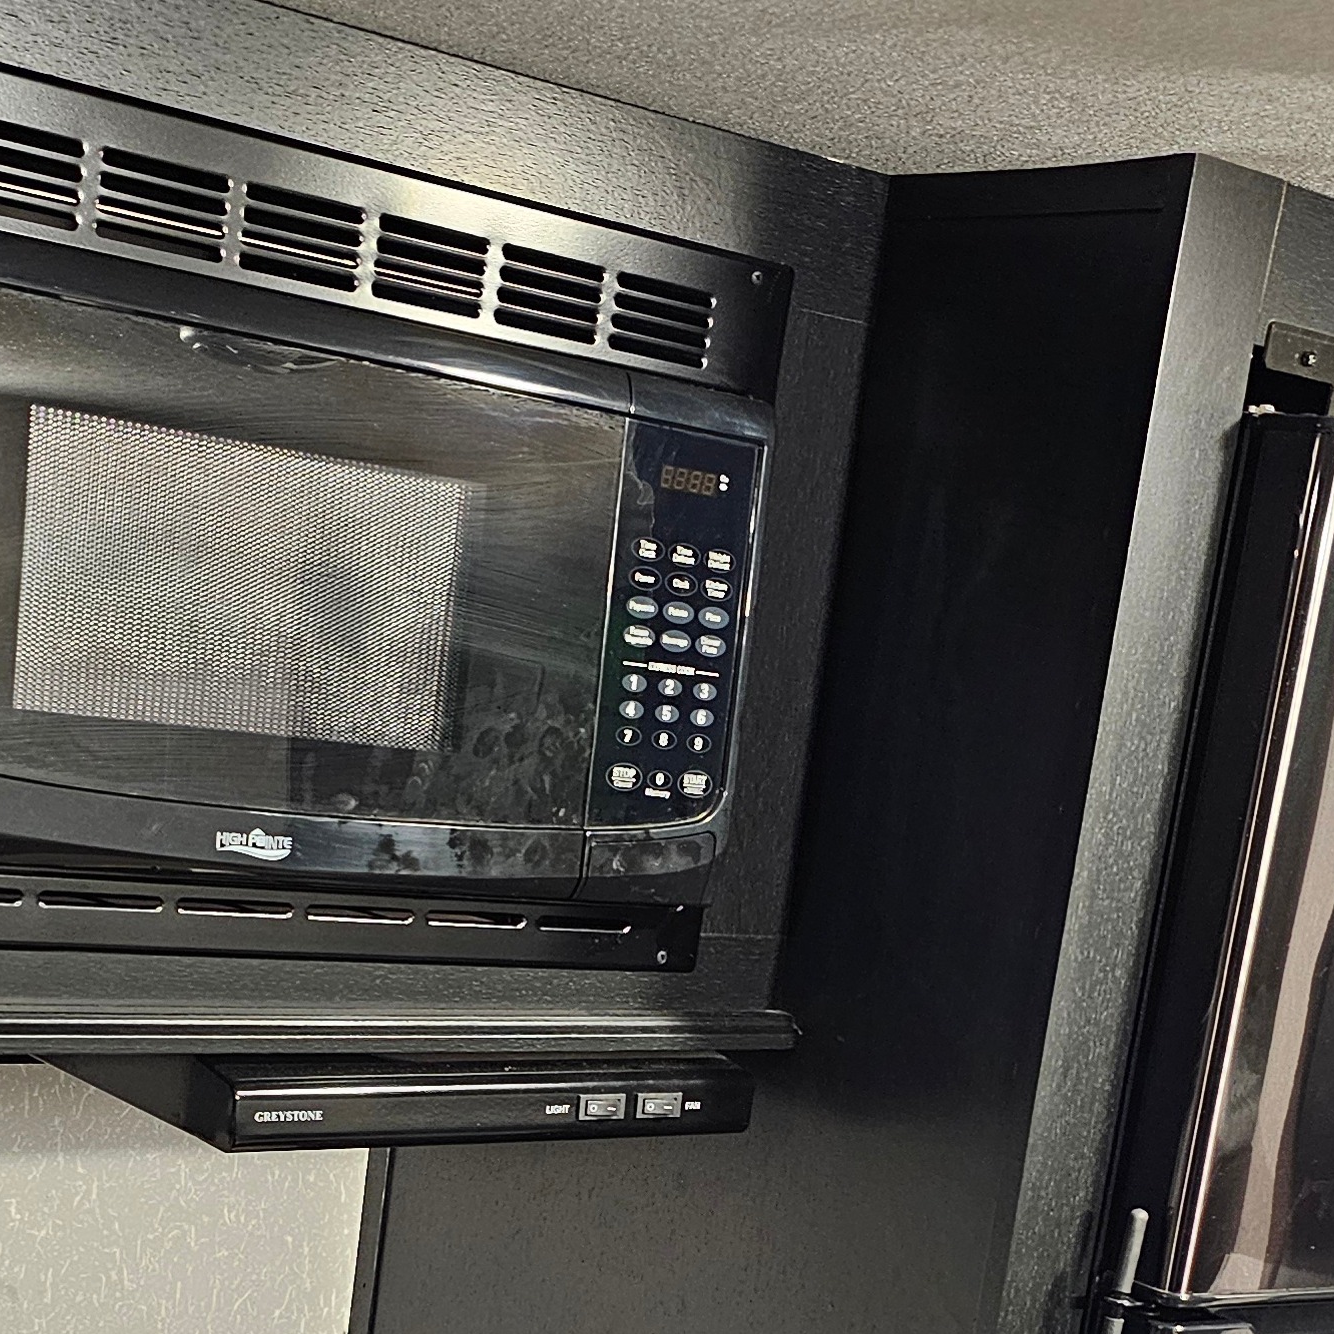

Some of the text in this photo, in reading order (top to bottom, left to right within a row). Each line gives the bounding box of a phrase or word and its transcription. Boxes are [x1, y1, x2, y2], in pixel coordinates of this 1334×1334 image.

[630, 674, 709, 698] 1 2 3
[626, 701, 706, 725] 4 5 6
[624, 729, 703, 750] 7 8 9
[656, 773, 664, 785] 0
[216, 831, 292, 850] HIGH POINTE
[546, 1104, 570, 1114] LIGHT
[685, 1101, 701, 1110] FAN
[254, 1110, 323, 1122] GREYSTONE
